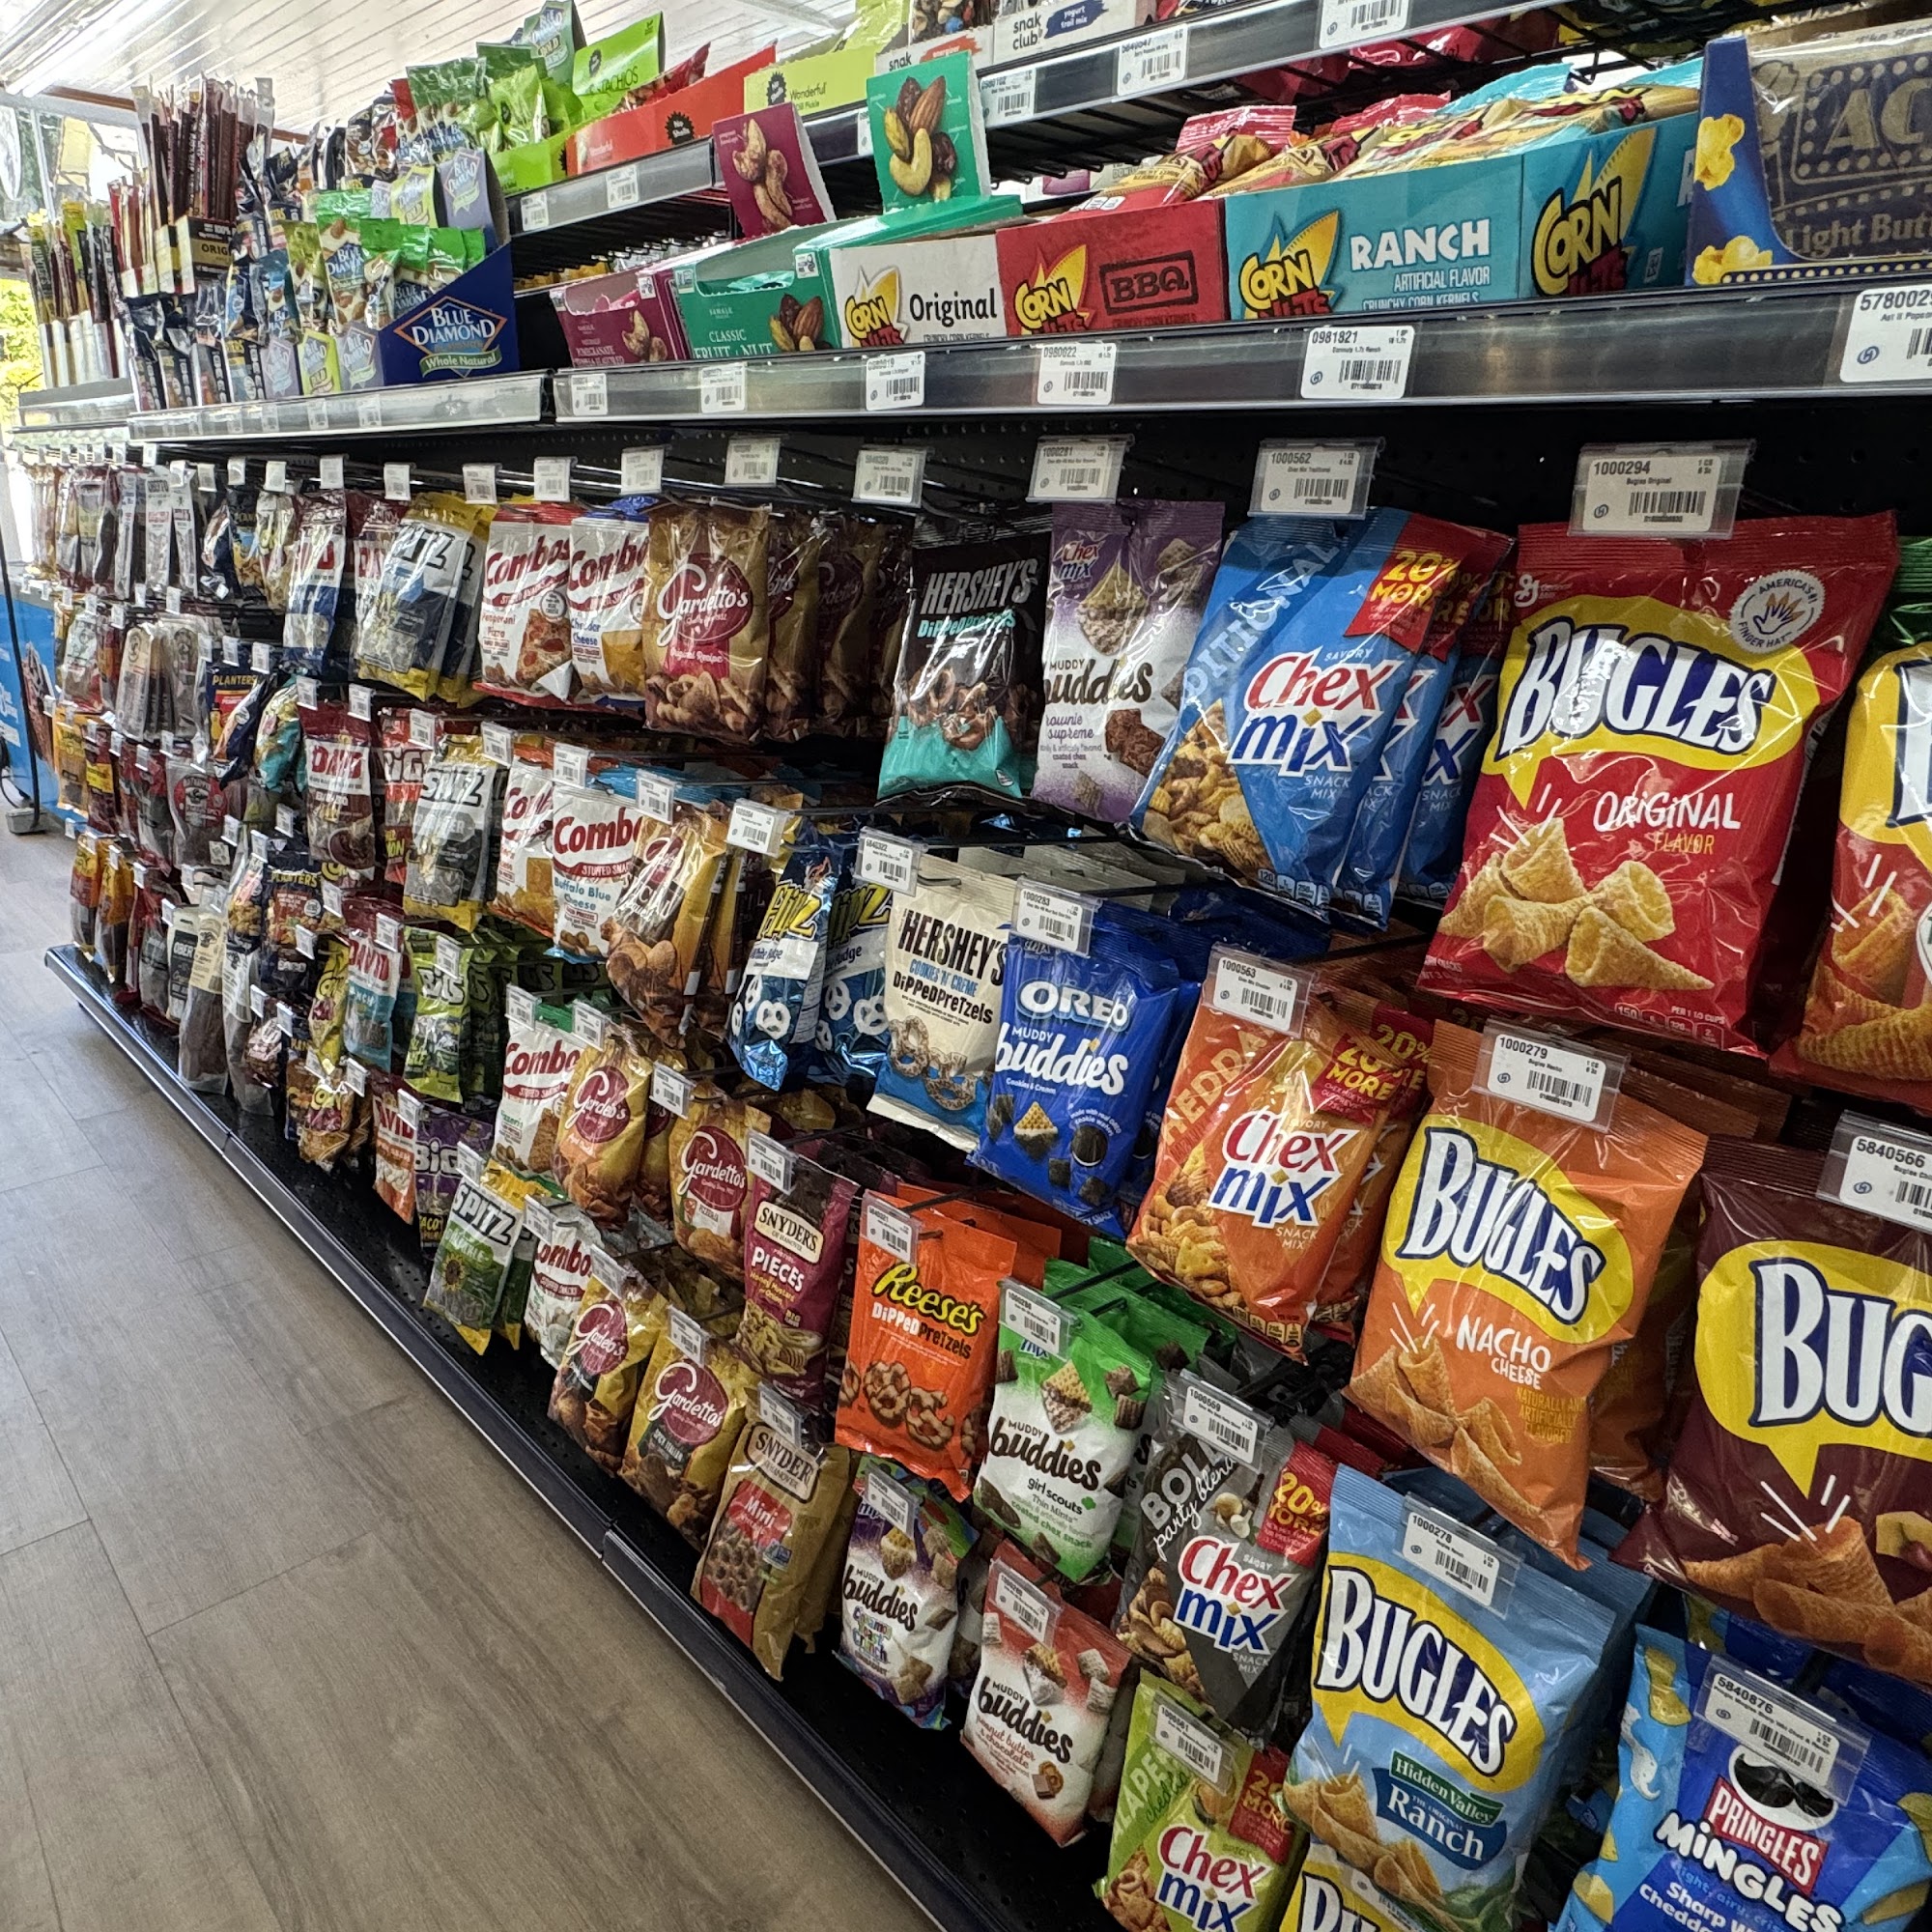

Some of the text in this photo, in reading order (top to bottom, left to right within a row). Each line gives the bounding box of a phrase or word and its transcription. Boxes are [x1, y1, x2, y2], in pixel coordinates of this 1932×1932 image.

[1013, 13, 1041, 33] snak
[1013, 30, 1038, 50] club
[790, 81, 827, 101] Wonderful
[1350, 217, 1492, 272] RANCH
[1531, 176, 1624, 297] CORN
[1109, 266, 1190, 304] BBQ
[1239, 248, 1316, 310] CORN
[1394, 266, 1491, 294] ARTIFICIAL FLAVOR
[431, 307, 472, 327] BLUE
[844, 294, 888, 337] CORN
[909, 287, 998, 327] Original
[1014, 277, 1077, 331] CORN
[412, 319, 496, 346] DIAMOND
[709, 329, 747, 342] CLASSIC
[1311, 330, 1359, 345] 0981821
[426, 353, 497, 369] Whole Natural
[1270, 451, 1312, 466] 1000562
[1594, 460, 1651, 475] 1000294
[1382, 551, 1461, 582] 20%
[656, 562, 749, 647] Gardetto's
[920, 558, 1038, 615] HERSHEY'S
[1759, 578, 1814, 595] AMERICA'S
[1738, 621, 1765, 647] FINGER
[213, 674, 257, 687] PLANTERS
[1049, 658, 1086, 670] MUDDY
[1246, 650, 1397, 712] Chex
[1495, 615, 1777, 756] BUGLES
[1047, 727, 1094, 745] supreme
[1232, 709, 1369, 774] mix
[1304, 776, 1351, 788] SNACK
[1311, 787, 1338, 799] MIX
[1592, 791, 1742, 832] ORIGINAL
[1653, 833, 1716, 856] FLAVOR
[588, 886, 611, 901] Blue
[897, 908, 1007, 986] HERSHEY'S
[909, 959, 940, 982] COOKIES
[951, 974, 979, 998] CREME
[1017, 981, 1131, 1030] OREO
[1011, 1027, 1054, 1042] MUDDY
[1498, 1036, 1548, 1060] 1000279
[996, 1024, 1129, 1095] buddies
[1006, 1077, 1057, 1094] Cookies Cream
[1325, 1063, 1395, 1100] MORE
[1225, 1110, 1350, 1173] Chex
[1857, 1138, 1926, 1168] 5840566
[677, 1130, 746, 1196] Gardetto's
[1212, 1165, 1333, 1224] mix
[758, 1207, 819, 1253] SNYDER'S
[1274, 1228, 1318, 1241] SNACK
[1282, 1237, 1304, 1250] MIX
[1395, 1126, 1606, 1326] BUGLES
[752, 1246, 805, 1293] PIECES
[871, 1262, 985, 1339] Reese's
[1456, 1314, 1551, 1373] NACHO
[1491, 1356, 1542, 1390] CHEESE
[647, 1362, 724, 1428] Gardetto's
[1517, 1386, 1565, 1411] NATURALLY
[1009, 1419, 1043, 1438] MUDDY
[1519, 1405, 1578, 1429] ARTIFICIALLY
[1524, 1423, 1572, 1444] FLAVORED
[990, 1416, 1101, 1492] buddies
[744, 1495, 779, 1527] Mini
[1028, 1478, 1083, 1515] girl scouts
[1032, 1493, 1050, 1510] Thin
[1011, 1500, 1039, 1524] coated
[1040, 1520, 1062, 1538] chex
[1152, 1498, 1202, 1562] party
[1412, 1515, 1453, 1544] 1000278
[1180, 1537, 1293, 1611] Chex
[842, 1564, 919, 1633] buddies
[1177, 1586, 1278, 1651] mix
[1232, 1652, 1269, 1667] SNACK
[1238, 1662, 1260, 1674] MIX
[1314, 1566, 1518, 1777] BUGLES
[992, 1682, 1024, 1703] MUDDY
[1717, 1676, 1774, 1715] 5840876
[978, 1676, 1073, 1764] buddies
[1396, 1758, 1493, 1824] Hidden Valley
[1387, 1783, 1484, 1861] Ranch
[1708, 1785, 1821, 1887] PRINGLES
[1158, 1826, 1265, 1899] Chex
[1665, 1882, 1727, 1928] Sharp
